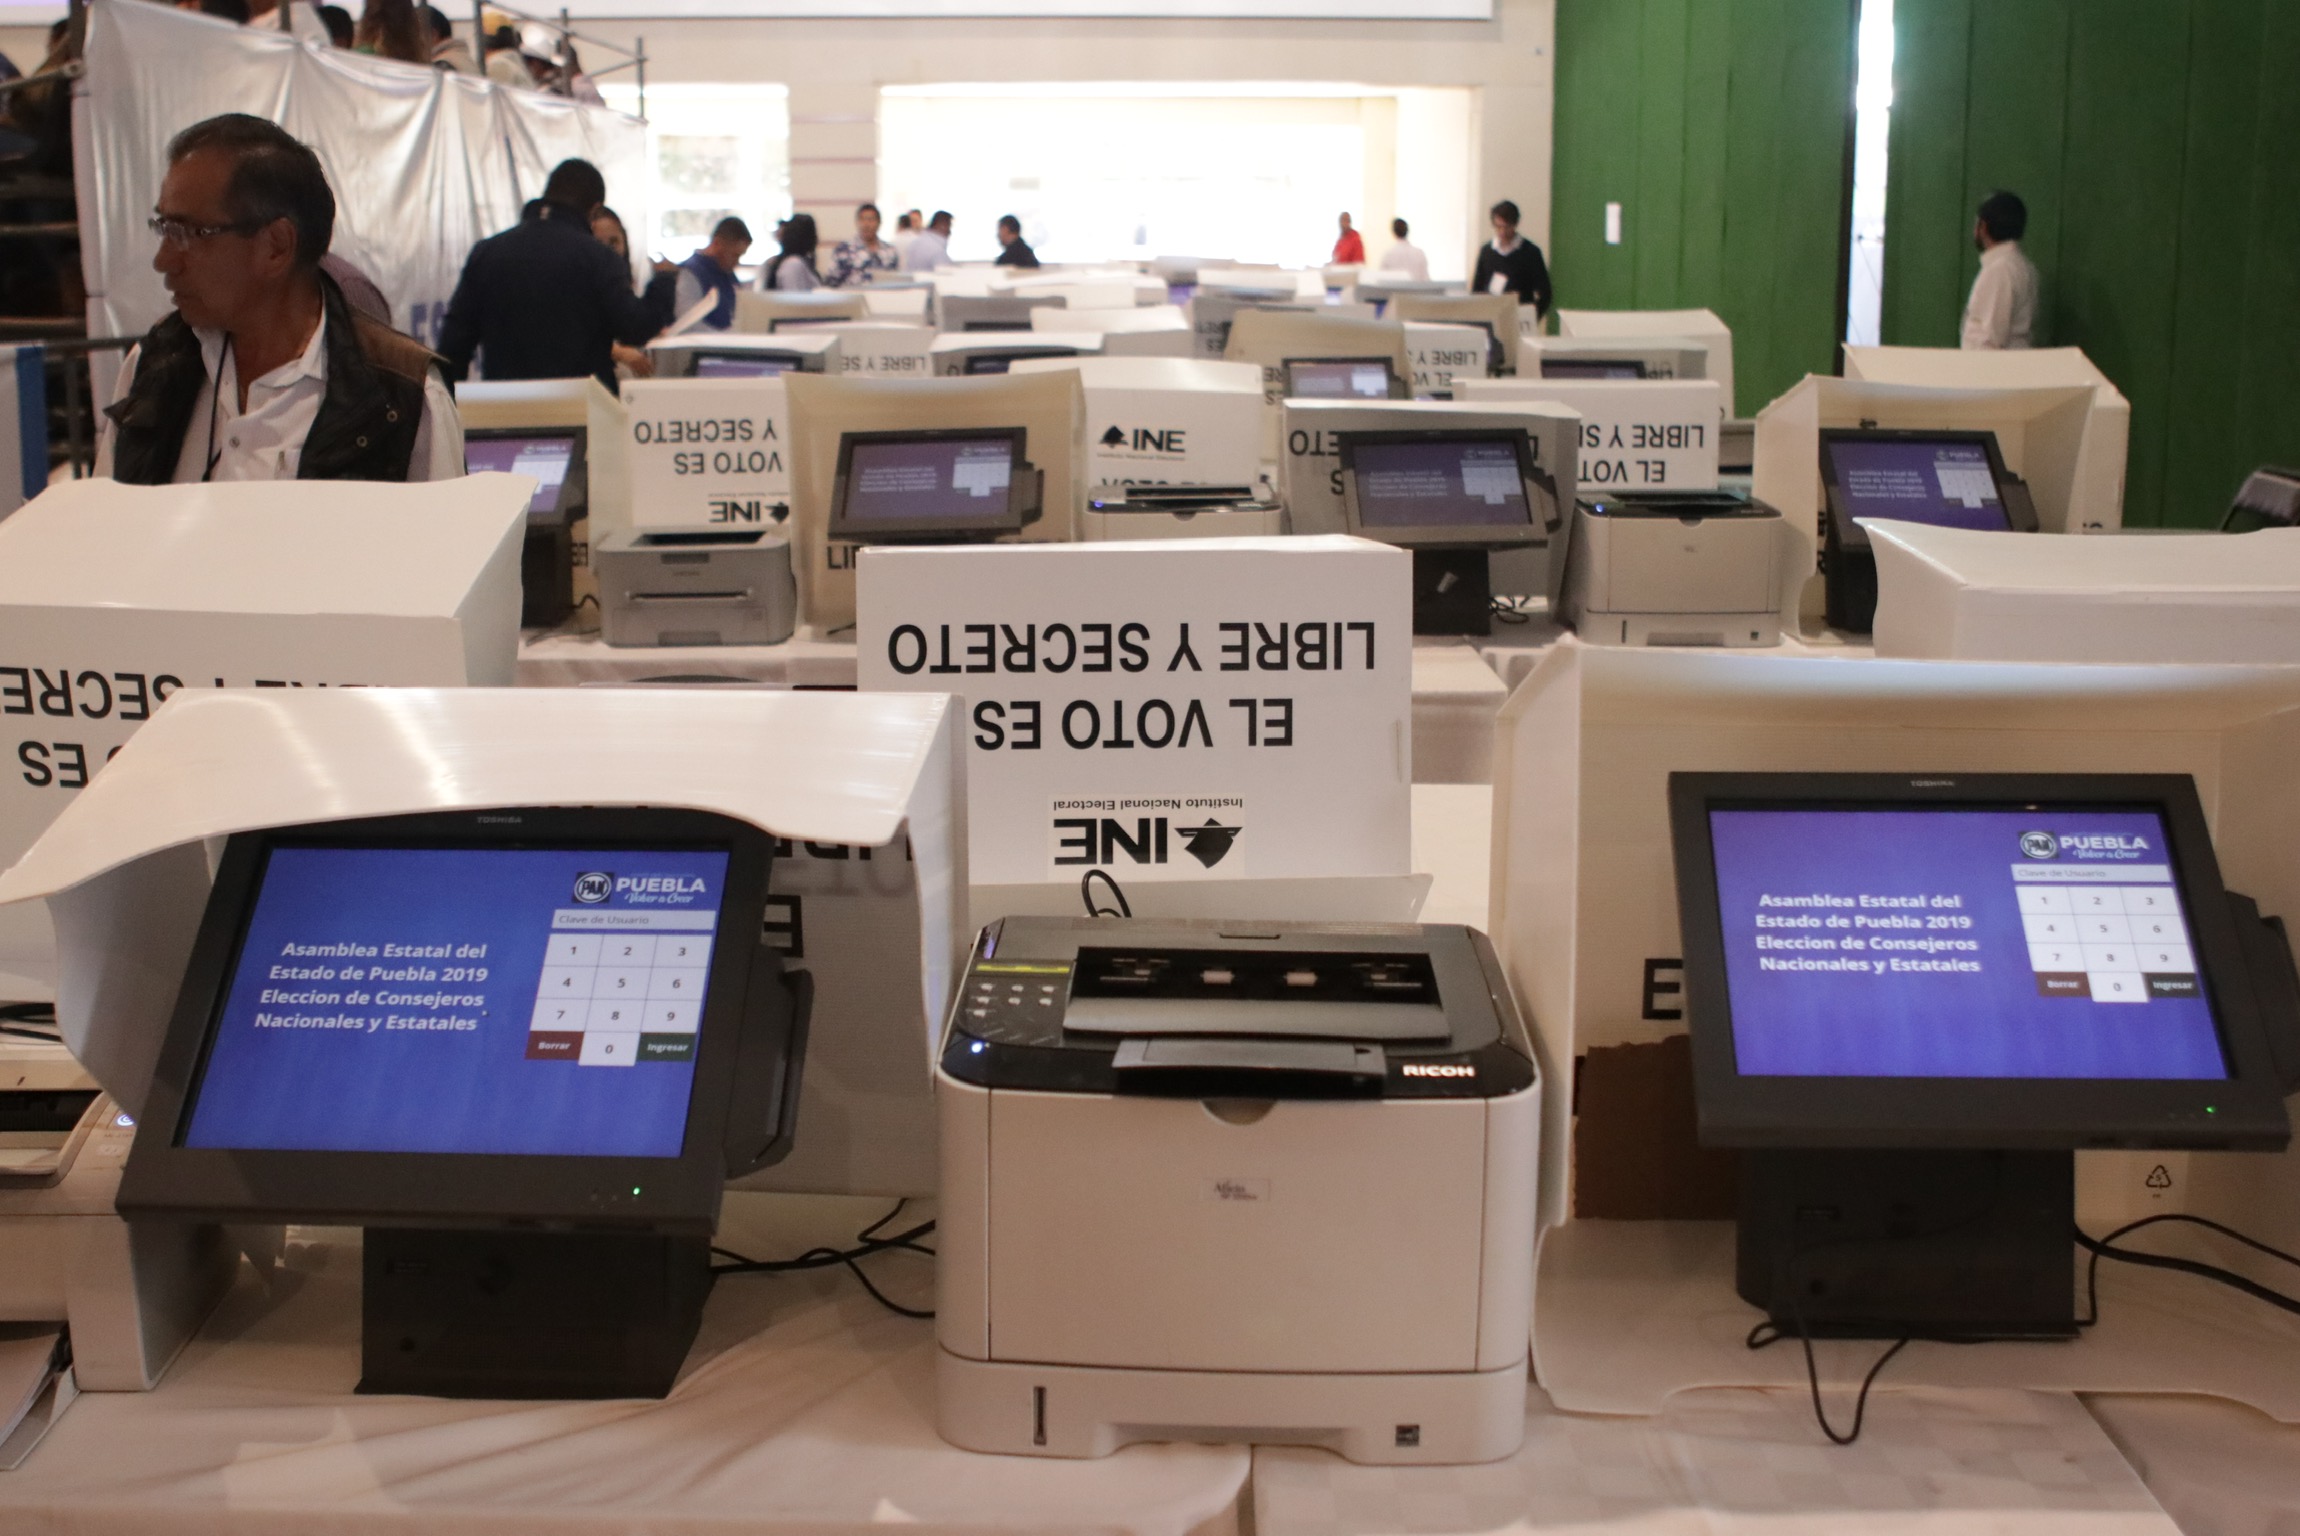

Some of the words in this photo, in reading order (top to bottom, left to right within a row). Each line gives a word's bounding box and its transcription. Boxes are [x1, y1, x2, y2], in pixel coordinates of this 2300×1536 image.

[864, 354, 875, 371] Y
[880, 355, 926, 372] LIBRE
[1416, 350, 1427, 365] Y
[1431, 350, 1477, 366] LIBRE
[1434, 372, 1453, 387] EL
[634, 418, 753, 445] SECRETO
[762, 417, 778, 441] Y
[1608, 424, 1625, 449] Y
[1631, 424, 1704, 449] LIBRE
[1132, 428, 1187, 453] INE
[673, 452, 706, 476] ES
[713, 450, 784, 475] VOTO
[1636, 460, 1666, 483] EL
[708, 500, 761, 524] INE
[887, 622, 1151, 675] SECRETO
[1166, 621, 1203, 673] Y
[1219, 621, 1376, 673] LIBRE
[973, 700, 1042, 752] ES
[1061, 698, 1214, 751] VOTO
[1228, 697, 1294, 748] EL
[17, 740, 90, 791] ES
[1053, 800, 1116, 812] Electoral
[1120, 799, 1182, 811] Nacional
[1185, 798, 1244, 809] Instituto
[477, 816, 523, 824] TOSHIBA
[1053, 817, 1169, 866] INE
[2060, 835, 2149, 850] PUEBLA
[580, 877, 606, 895] PAN
[615, 877, 706, 893] PUEBLA
[1759, 893, 1855, 908] Asamblea
[1858, 894, 1927, 909] Estatal
[1930, 894, 1961, 909] del
[2041, 896, 2048, 905] 1
[2092, 896, 2102, 906] 2
[2145, 897, 2154, 906] 3
[558, 915, 587, 924] Clave
[590, 915, 604, 924] de
[607, 916, 649, 925] Usuario
[1755, 914, 1822, 928] Estado
[1825, 914, 1850, 929] de
[1854, 915, 1922, 929] Puebla
[1925, 916, 1972, 929] 2019
[2046, 924, 2056, 933] 4
[2099, 924, 2108, 934] 5
[2152, 925, 2161, 934] 6
[281, 942, 378, 958] Asamblea
[383, 943, 451, 958] Estatal
[455, 944, 487, 959] del
[570, 946, 577, 956] 1
[623, 946, 632, 956] 2
[677, 947, 686, 957] 3
[1755, 935, 1836, 950] Eleccion
[1840, 936, 1865, 950] de
[1869, 936, 1979, 954] Consejeros
[1759, 957, 1870, 972] Nacionales
[1873, 961, 1886, 975] y
[1889, 958, 1982, 973] Estatales
[2052, 953, 2061, 962] 7
[2106, 953, 2115, 963] 8
[2159, 954, 2168, 963] 9
[269, 965, 335, 980] Estado
[339, 966, 365, 981] de
[368, 966, 437, 982] Puebla
[441, 968, 488, 982] 2019
[562, 977, 571, 988] 4
[617, 978, 625, 988] 5
[672, 979, 681, 989] 6
[2152, 981, 2193, 992] Ingresar
[260, 989, 340, 1005] Eleccion
[344, 990, 370, 1006] de
[375, 991, 485, 1010] Consejeros
[254, 1013, 364, 1029] Nacionales
[367, 1018, 382, 1033] y
[385, 1015, 477, 1031] Estatales
[556, 1010, 566, 1020] 7
[610, 1010, 620, 1021] 8
[666, 1012, 675, 1022] 9
[538, 1041, 571, 1050] Borrar
[604, 1044, 613, 1054] 0
[647, 1043, 689, 1054] Ingresar
[1402, 1064, 1476, 1078] RICOH
